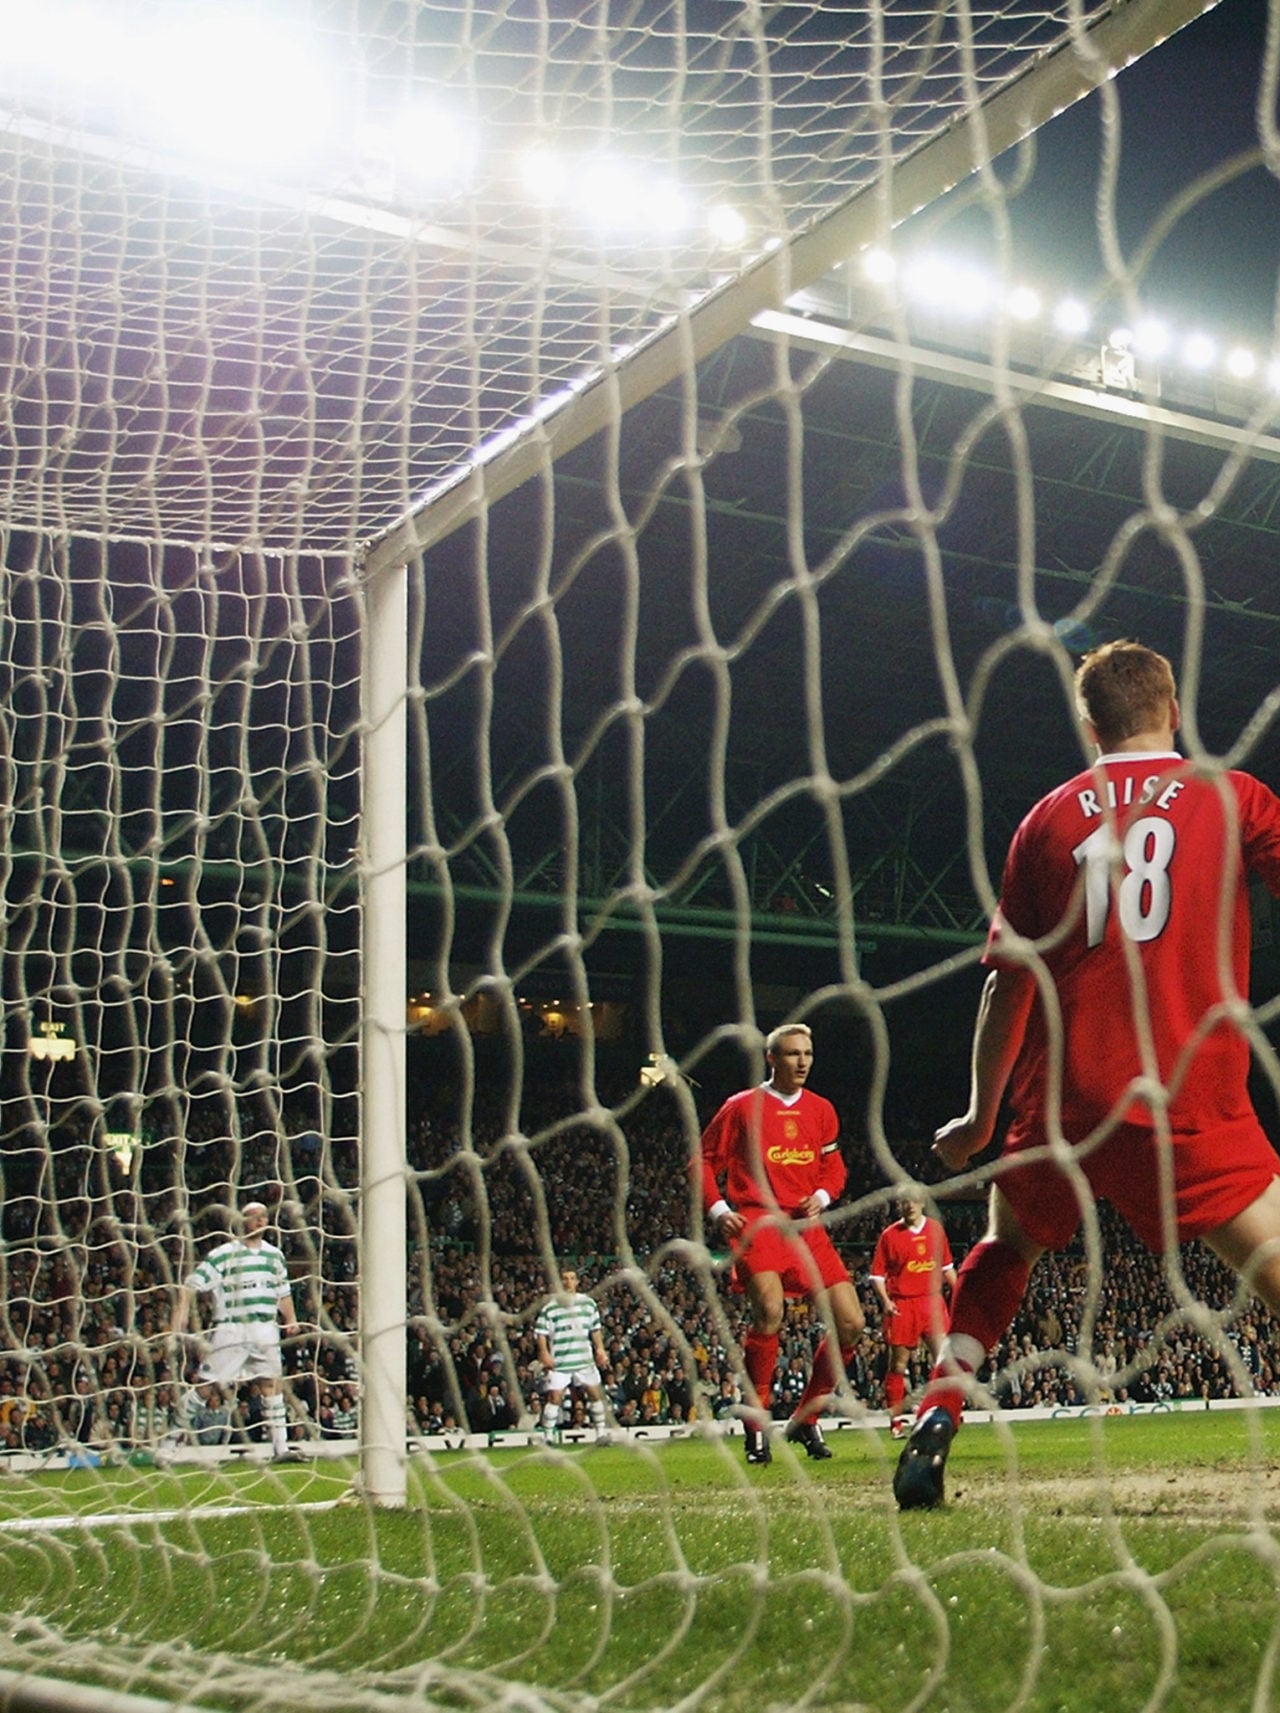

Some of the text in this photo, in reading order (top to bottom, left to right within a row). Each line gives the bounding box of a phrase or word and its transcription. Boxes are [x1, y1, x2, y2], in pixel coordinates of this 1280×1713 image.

[1077, 775, 1185, 818] RIISE
[1072, 816, 1176, 949] 18
[767, 1144, 814, 1166] Carlsberg
